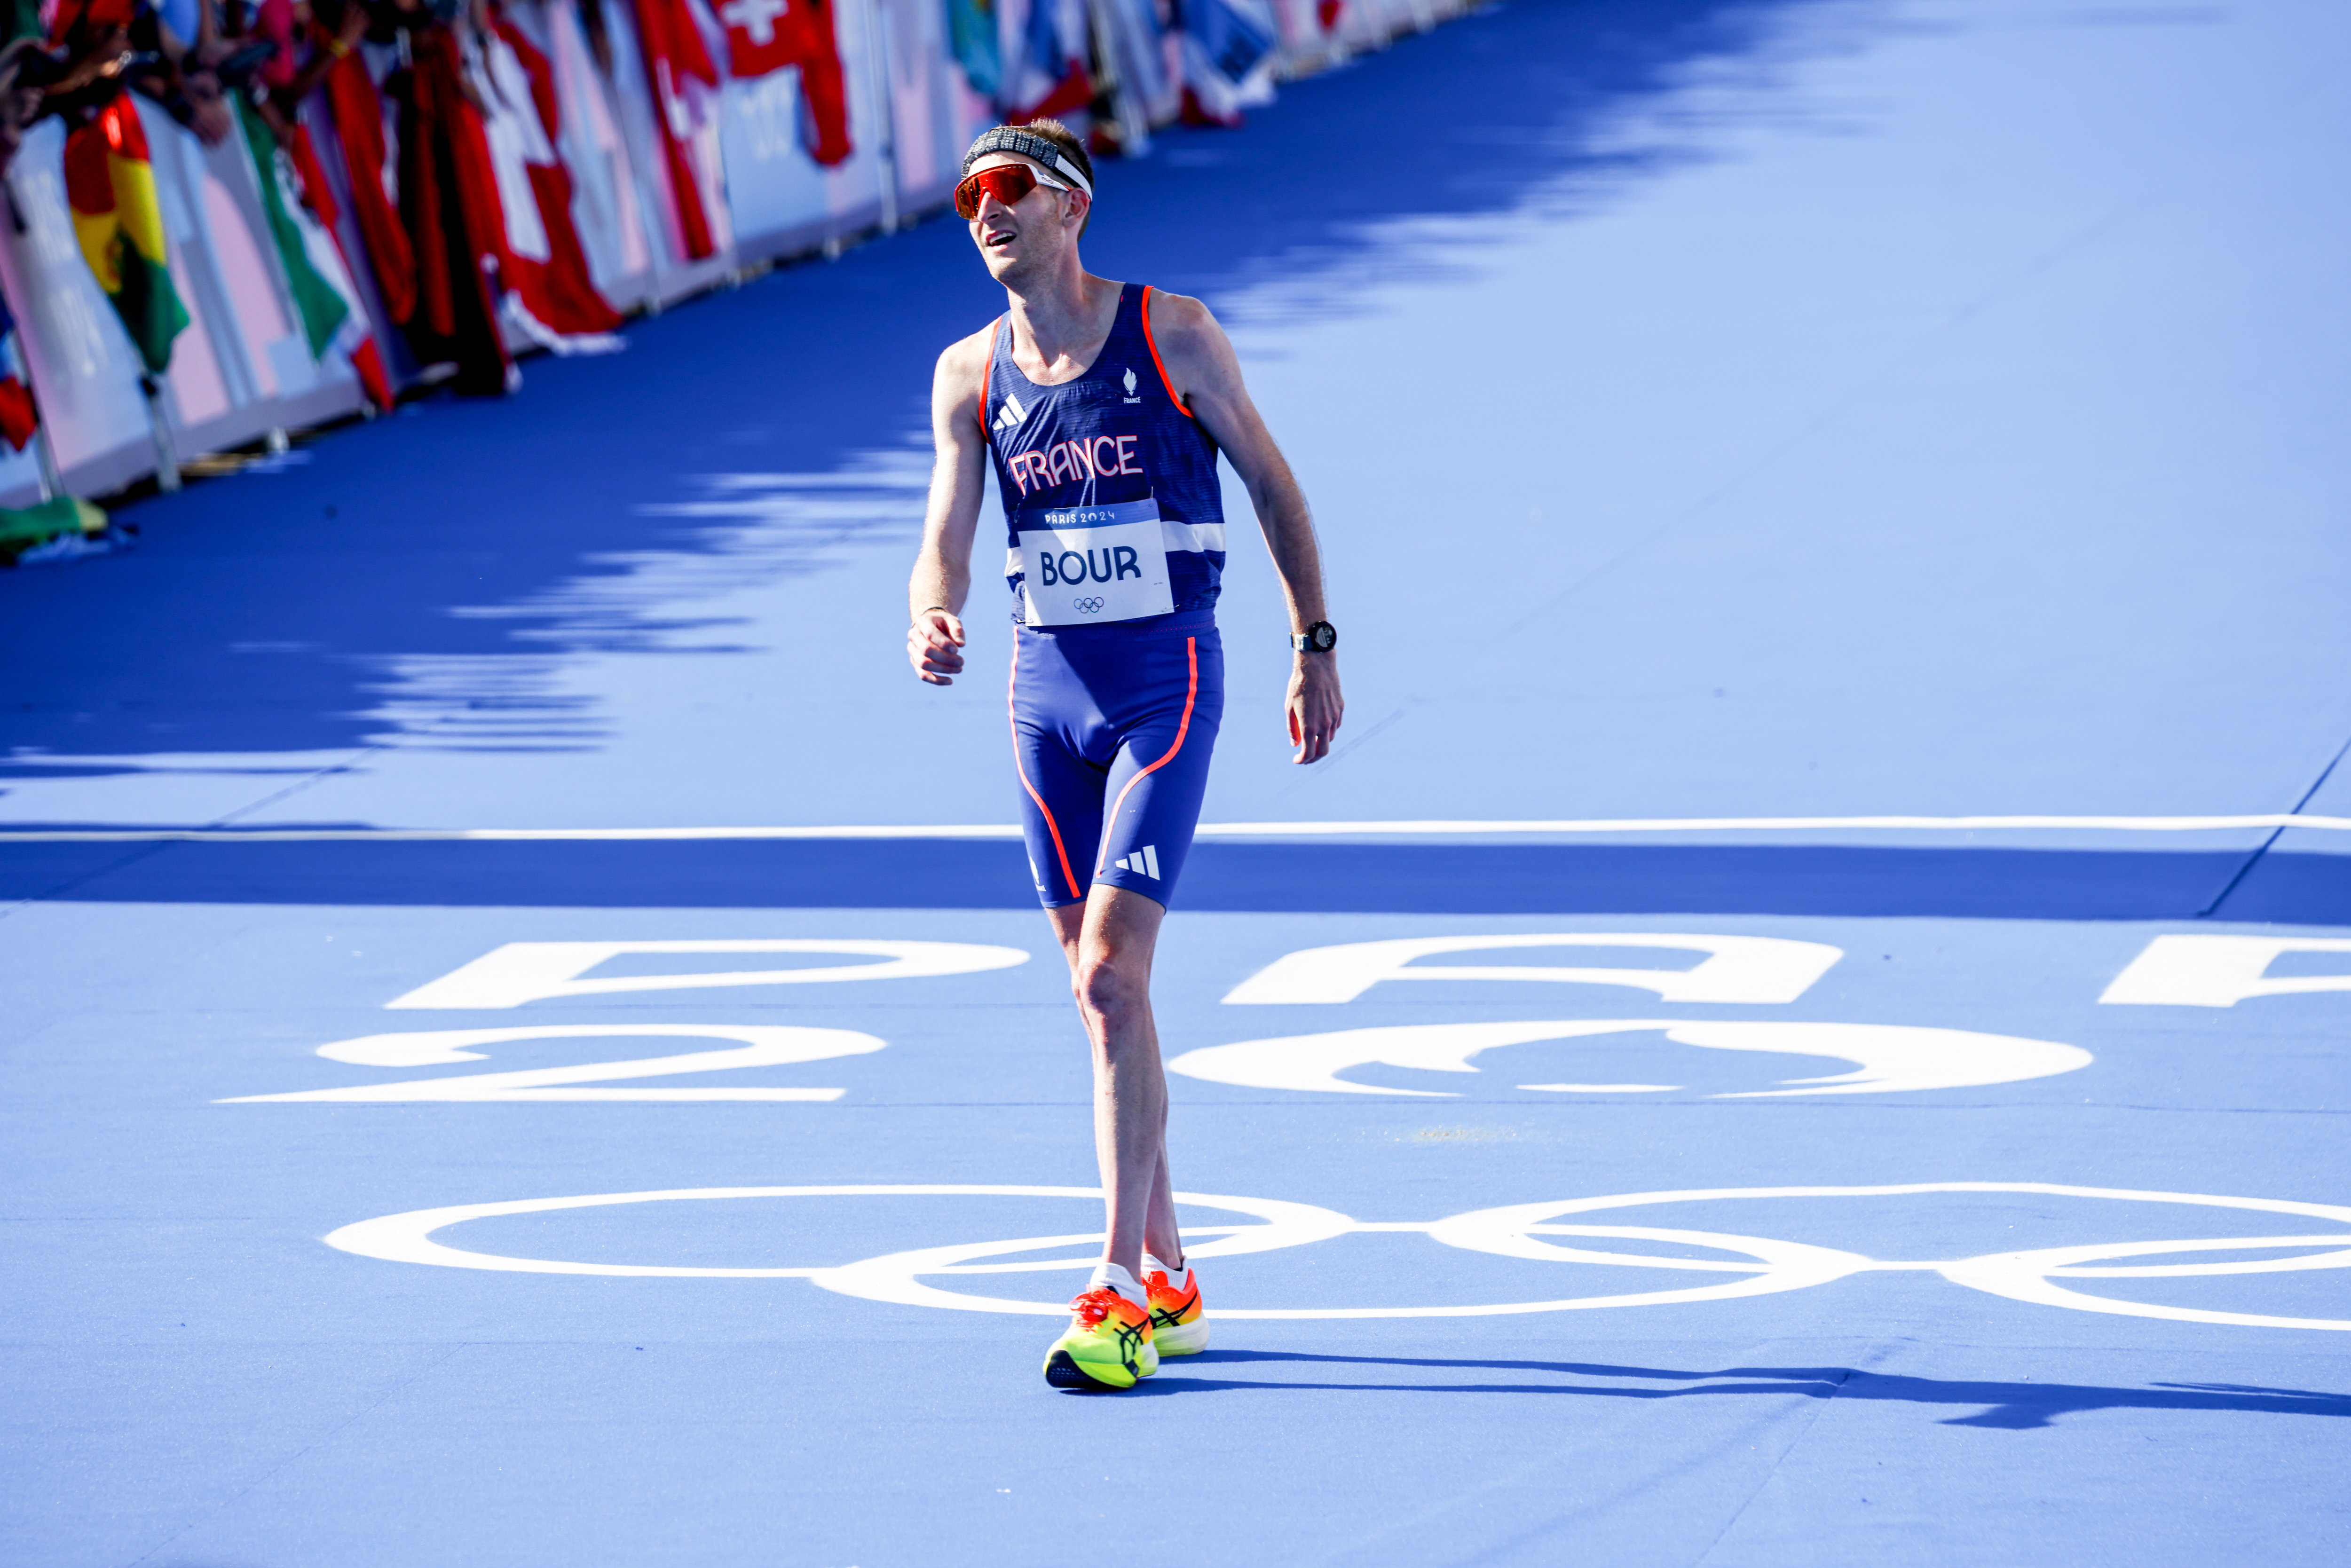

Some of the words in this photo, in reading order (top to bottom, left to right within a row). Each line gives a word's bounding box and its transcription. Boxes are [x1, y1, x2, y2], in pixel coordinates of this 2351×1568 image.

[1008, 435, 1143, 496] FRANCE
[1080, 511, 1115, 522] 2024
[1041, 546, 1142, 586] BOUR
